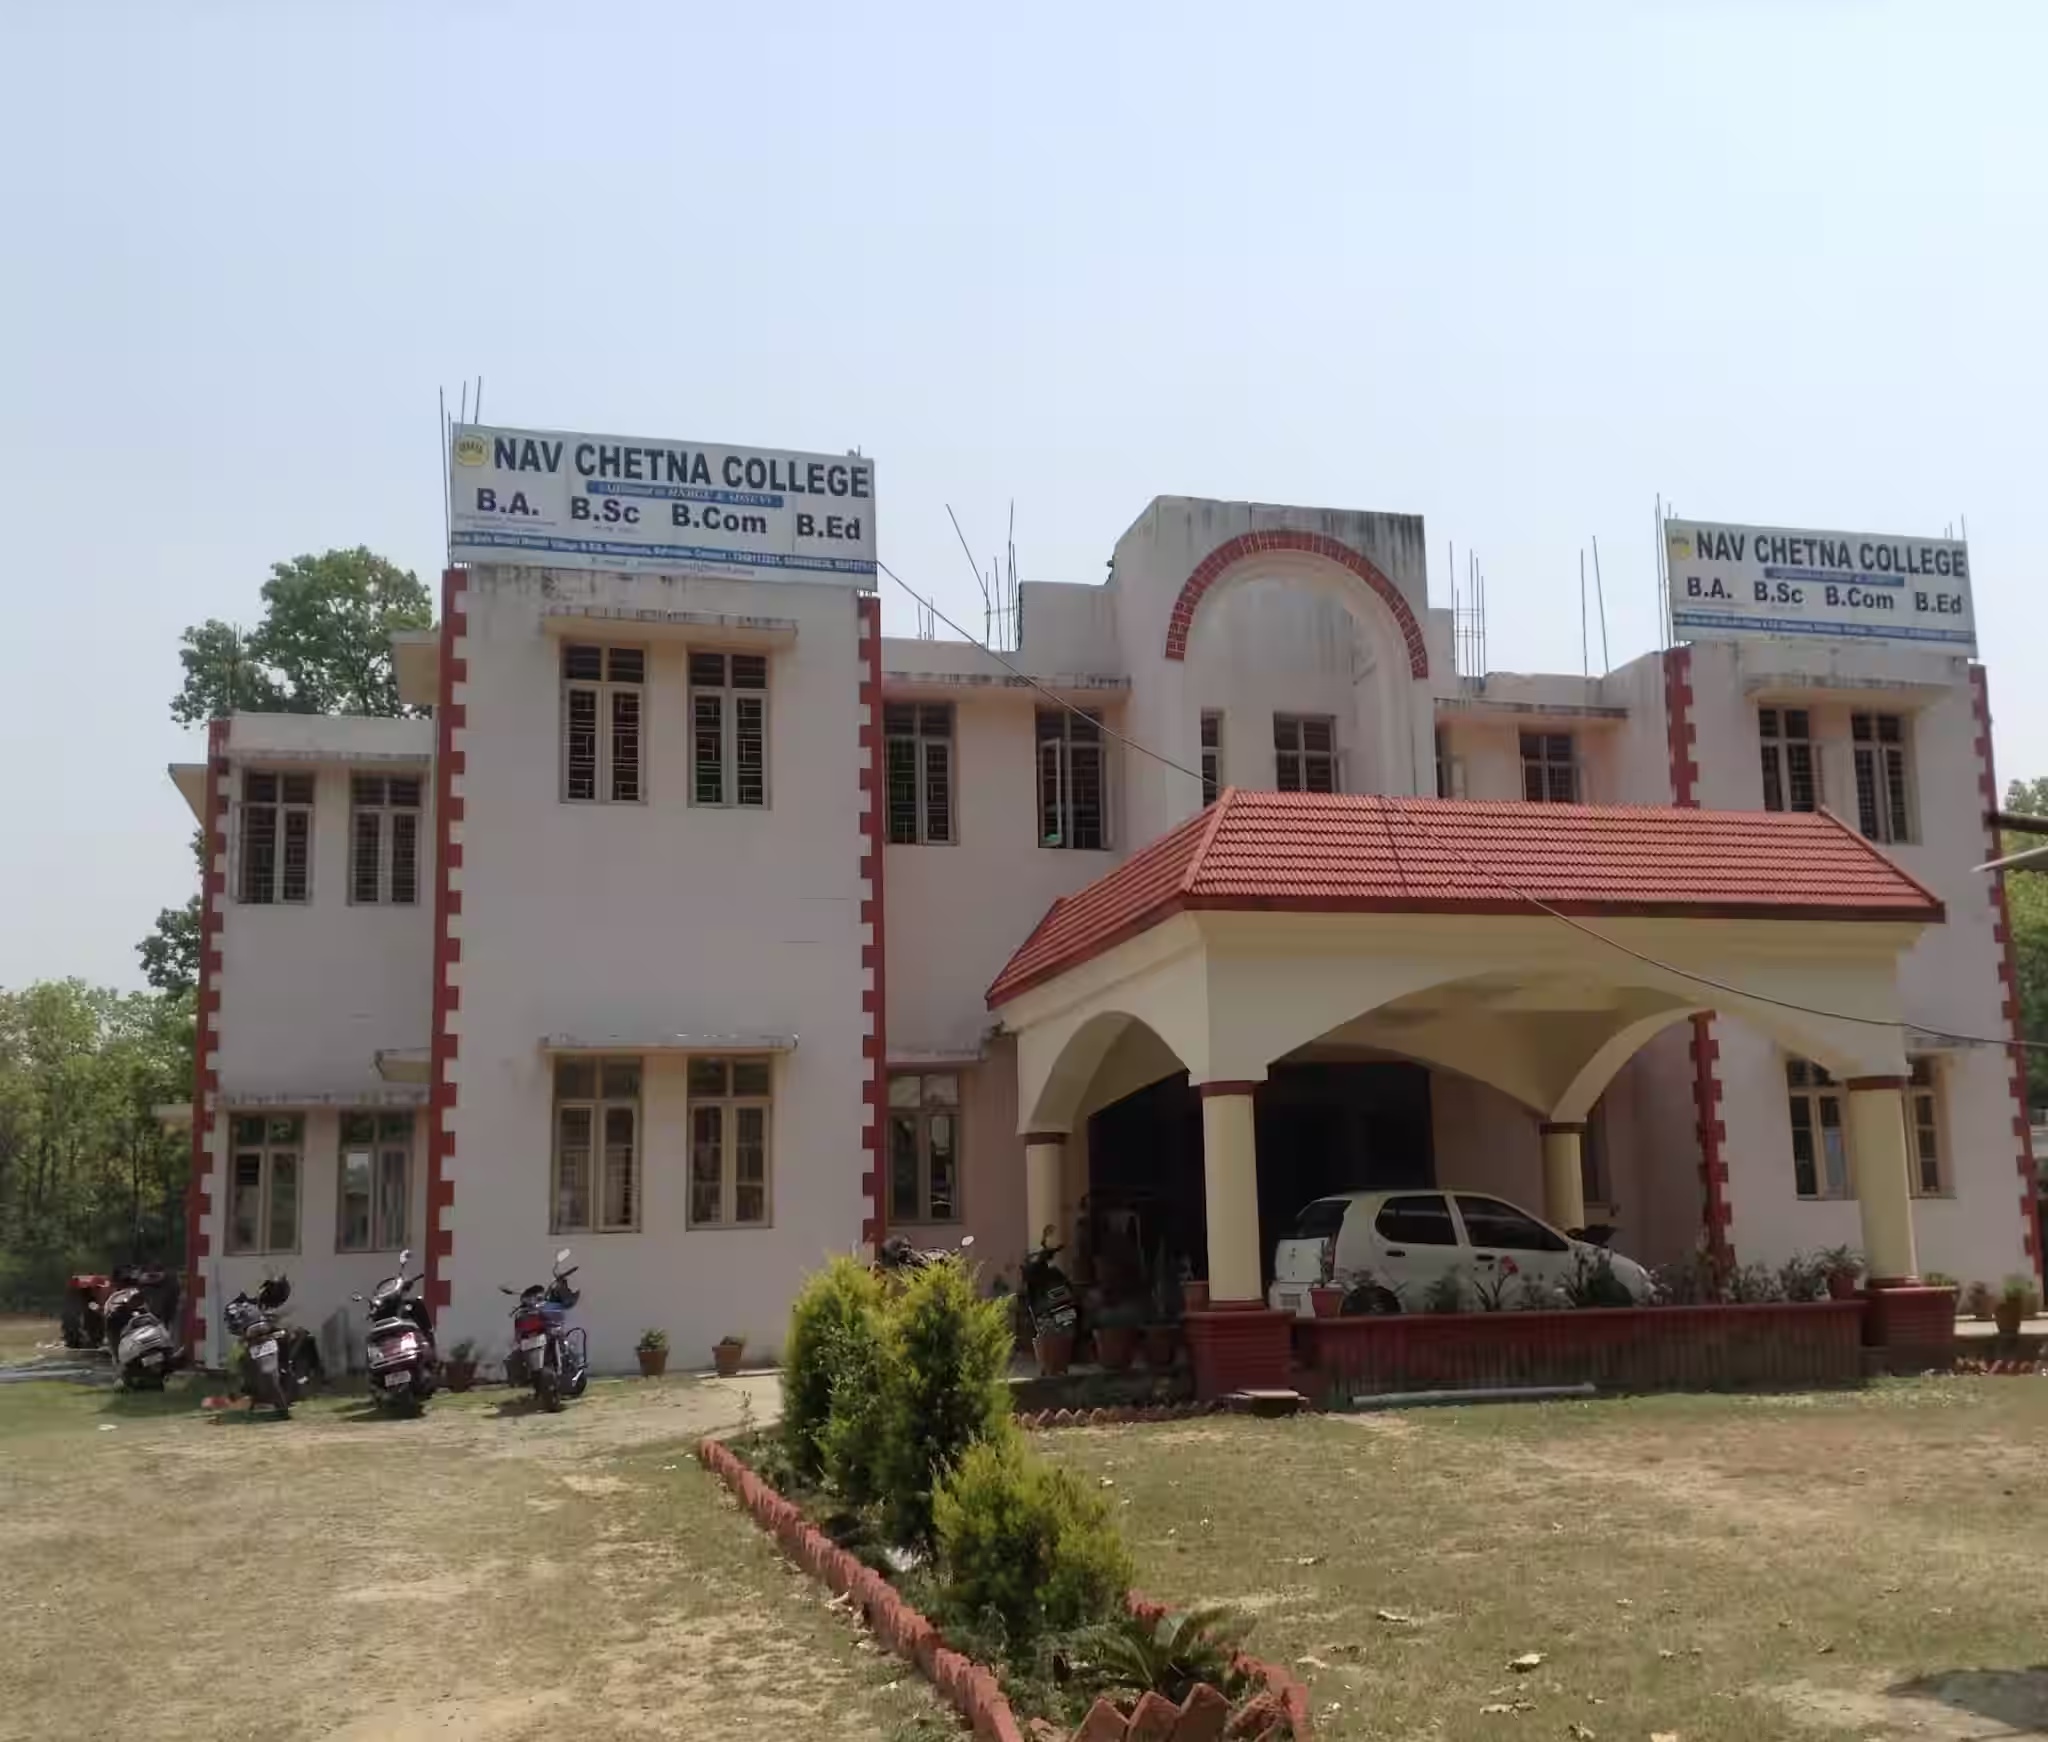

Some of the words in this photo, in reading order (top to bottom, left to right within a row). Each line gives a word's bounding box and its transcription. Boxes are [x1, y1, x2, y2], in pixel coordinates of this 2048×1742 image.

[494, 437, 563, 473] NAV
[575, 443, 711, 485] CHETNA
[722, 455, 869, 498] COLLEGE
[476, 487, 539, 515] B.A.
[571, 496, 640, 524] B.Sc
[671, 503, 767, 534] B.Com
[797, 513, 860, 540] B.Ed
[1696, 530, 1745, 562] NAV
[1754, 535, 1852, 569] CHETNA
[1860, 543, 1966, 577] COLLEGE
[1687, 577, 1732, 599] B.A.
[1753, 581, 1804, 604] B.Sc
[1826, 585, 1894, 610] B.Com
[1915, 591, 1962, 614] B.Ed
